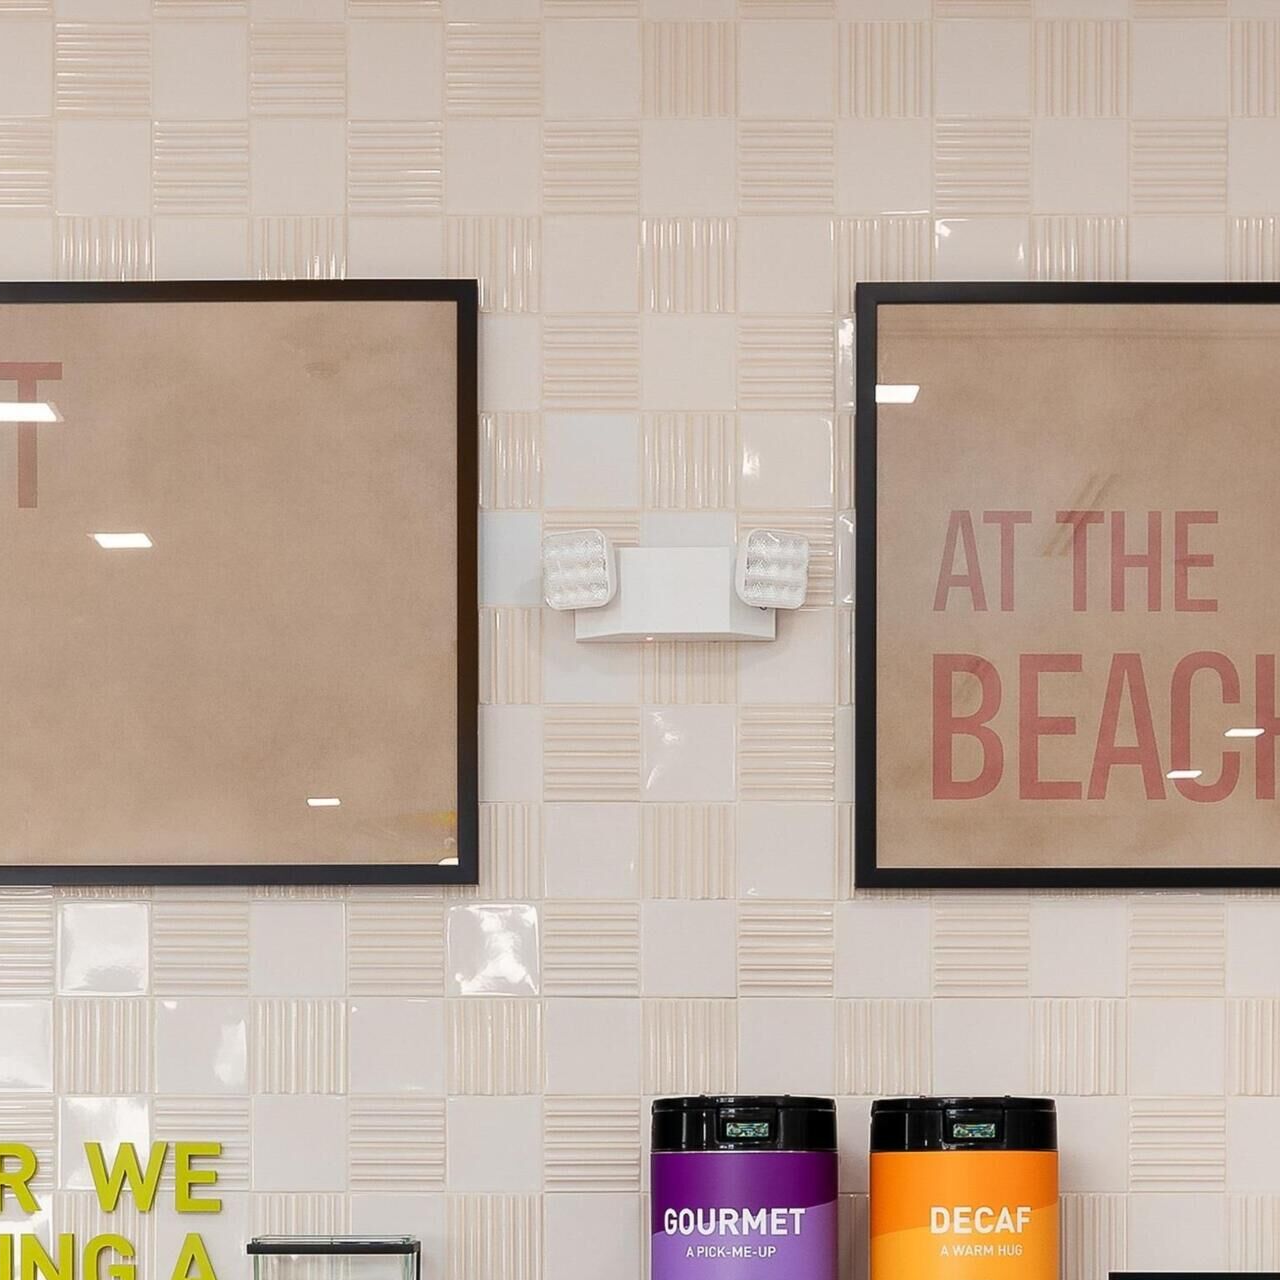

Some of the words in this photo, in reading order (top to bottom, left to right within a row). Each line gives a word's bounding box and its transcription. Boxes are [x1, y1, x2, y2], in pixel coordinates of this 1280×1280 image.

[931, 509, 1033, 612] AT
[1055, 509, 1220, 612] THE
[82, 1142, 223, 1213] WE
[664, 1207, 806, 1236] GOURMET
[930, 1206, 1032, 1234] DECAF
[686, 1246, 695, 1258] A
[697, 1246, 777, 1258] PICK-ME-UP
[940, 1244, 950, 1257] A
[952, 1244, 994, 1257] WARM
[998, 1244, 1023, 1256] HUG
